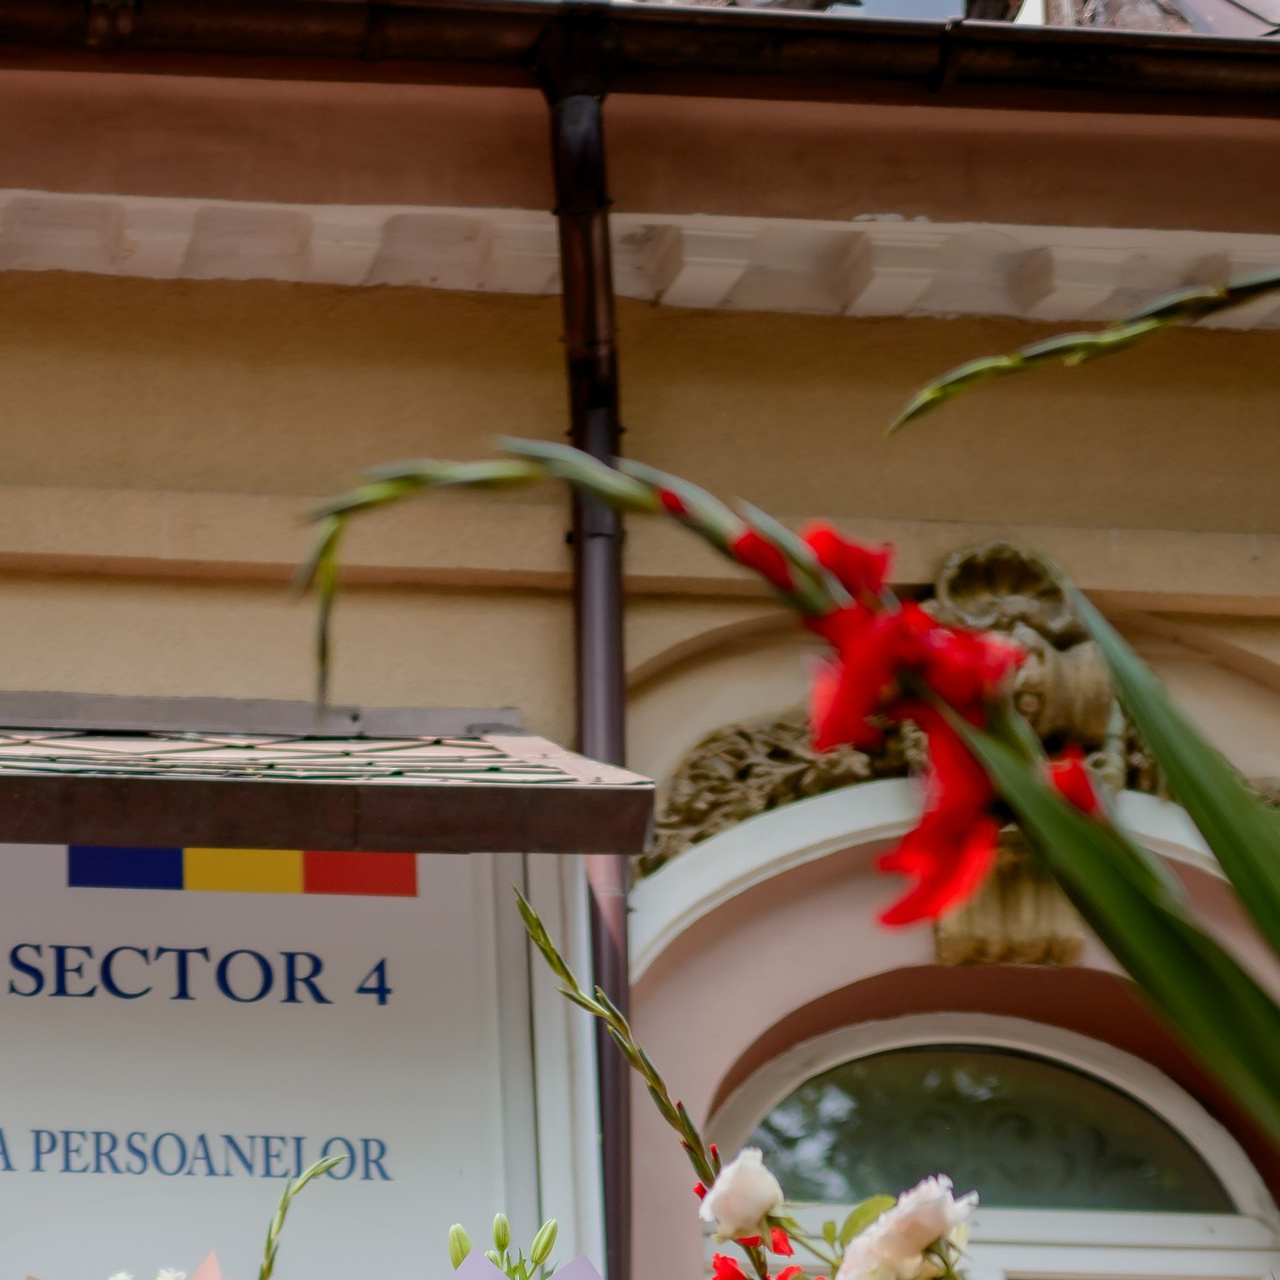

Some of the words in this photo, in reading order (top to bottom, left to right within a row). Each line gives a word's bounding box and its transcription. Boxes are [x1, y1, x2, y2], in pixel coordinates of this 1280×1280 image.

[7, 942, 334, 1006] SECTOR
[356, 957, 394, 1007] 4
[30, 1129, 394, 1182] PERSOANELOR
